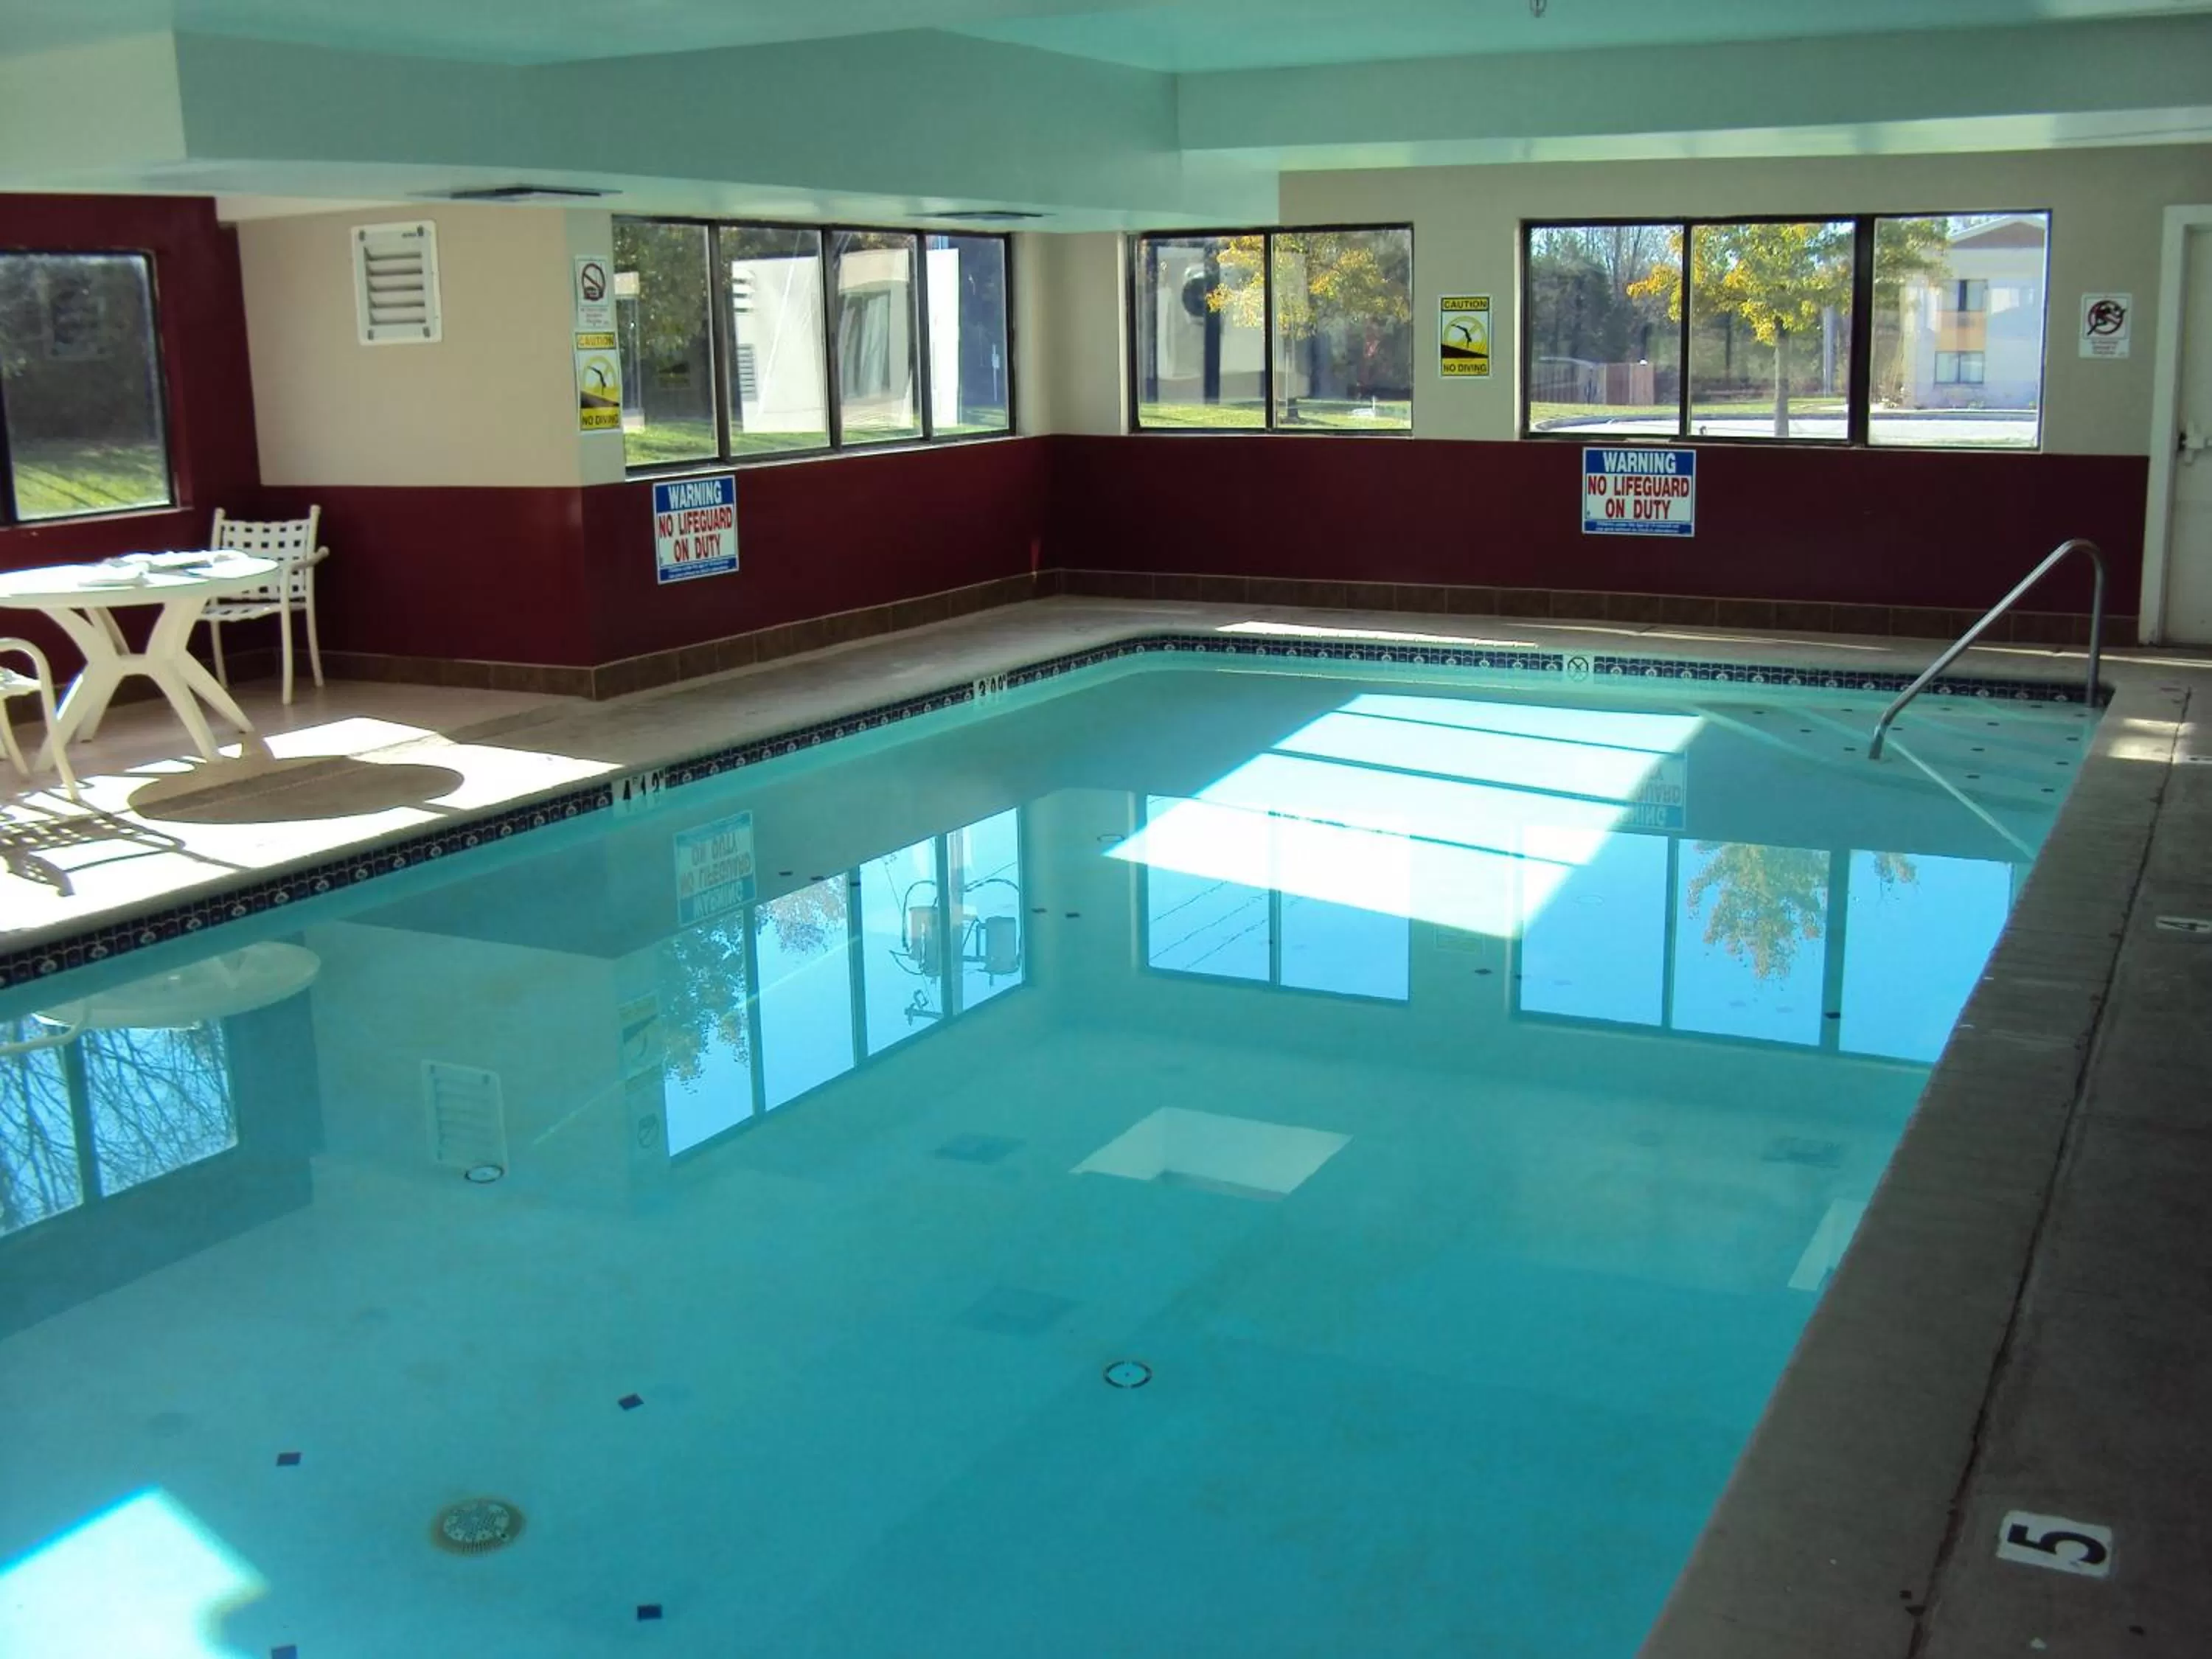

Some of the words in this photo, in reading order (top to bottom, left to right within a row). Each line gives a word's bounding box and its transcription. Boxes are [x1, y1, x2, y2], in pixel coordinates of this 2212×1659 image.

[1444, 300, 1486, 308] CAUTION
[579, 334, 614, 346] CAUTION
[1444, 364, 1455, 372] NO
[1458, 364, 1486, 372] DIVING
[582, 414, 593, 425] NO
[595, 414, 619, 425] DIVING
[1603, 451, 1676, 473] WARNING
[667, 481, 723, 509] WARNING
[1587, 476, 1607, 495] NO
[1614, 476, 1689, 497] LIFEGUARD
[1605, 498, 1624, 518] ON
[1634, 499, 1671, 519] DUTY
[658, 514, 673, 538] NO
[678, 507, 732, 535] LIFEGUARD
[674, 538, 689, 562] ON
[695, 534, 720, 558] DUTY
[2007, 1523, 2107, 1565] 5
